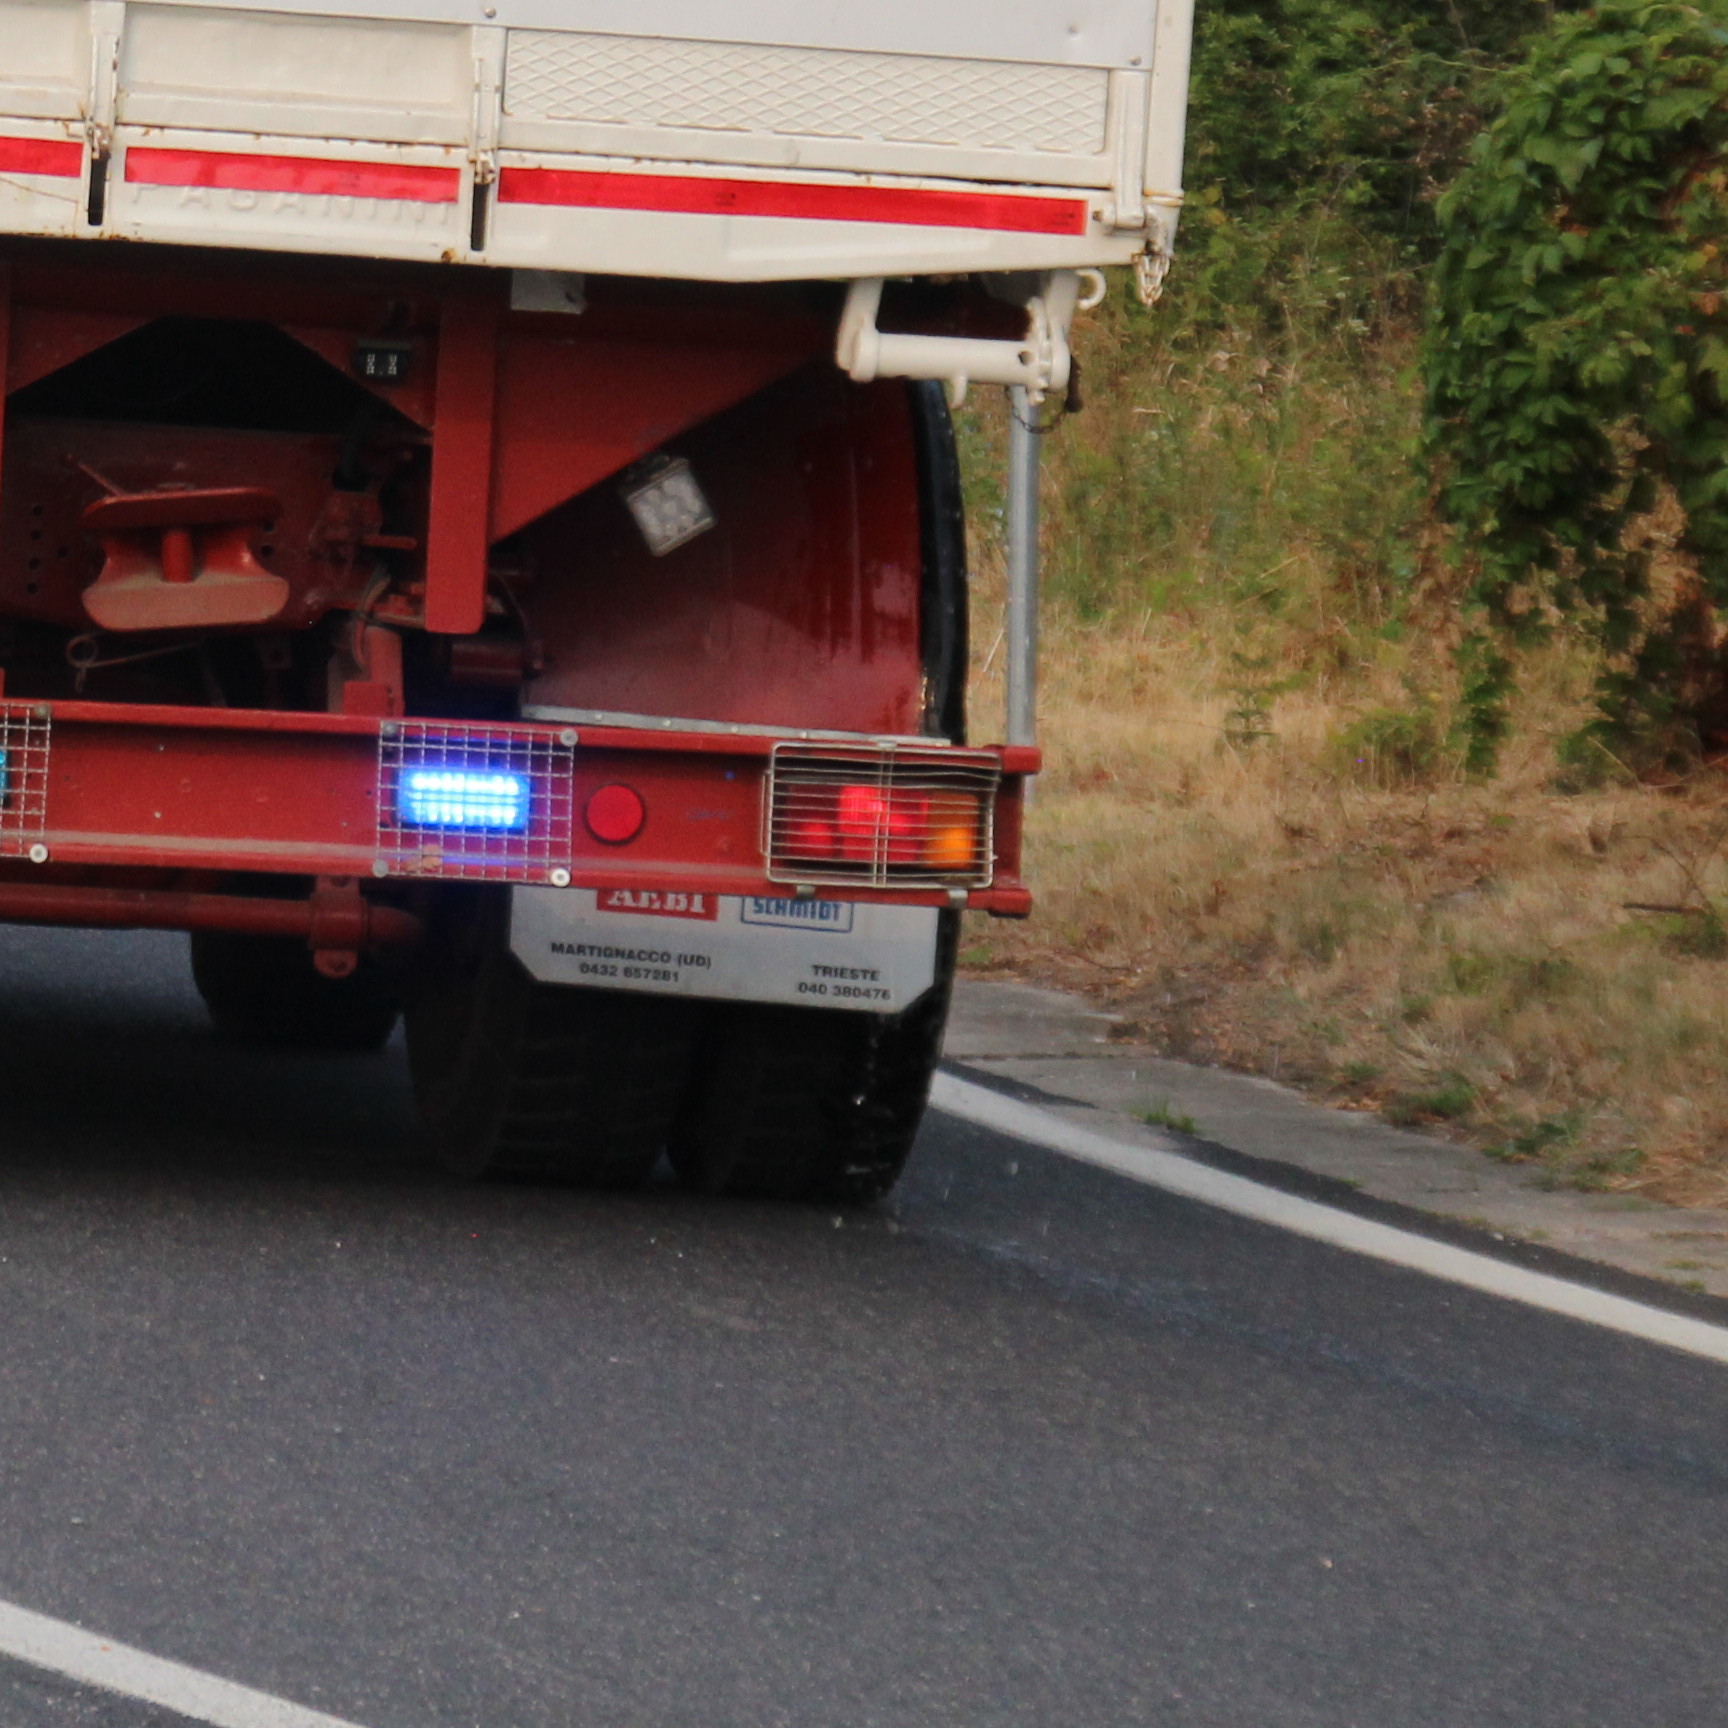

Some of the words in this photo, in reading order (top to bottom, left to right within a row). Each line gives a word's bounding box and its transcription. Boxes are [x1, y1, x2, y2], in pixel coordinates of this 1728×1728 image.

[550, 942, 672, 964] MARTIGNACCO
[676, 950, 713, 970] (UD)
[579, 962, 618, 977] 0432
[810, 963, 881, 982] TRIESTE
[798, 981, 828, 996] 040
[832, 984, 893, 1002] 380476
